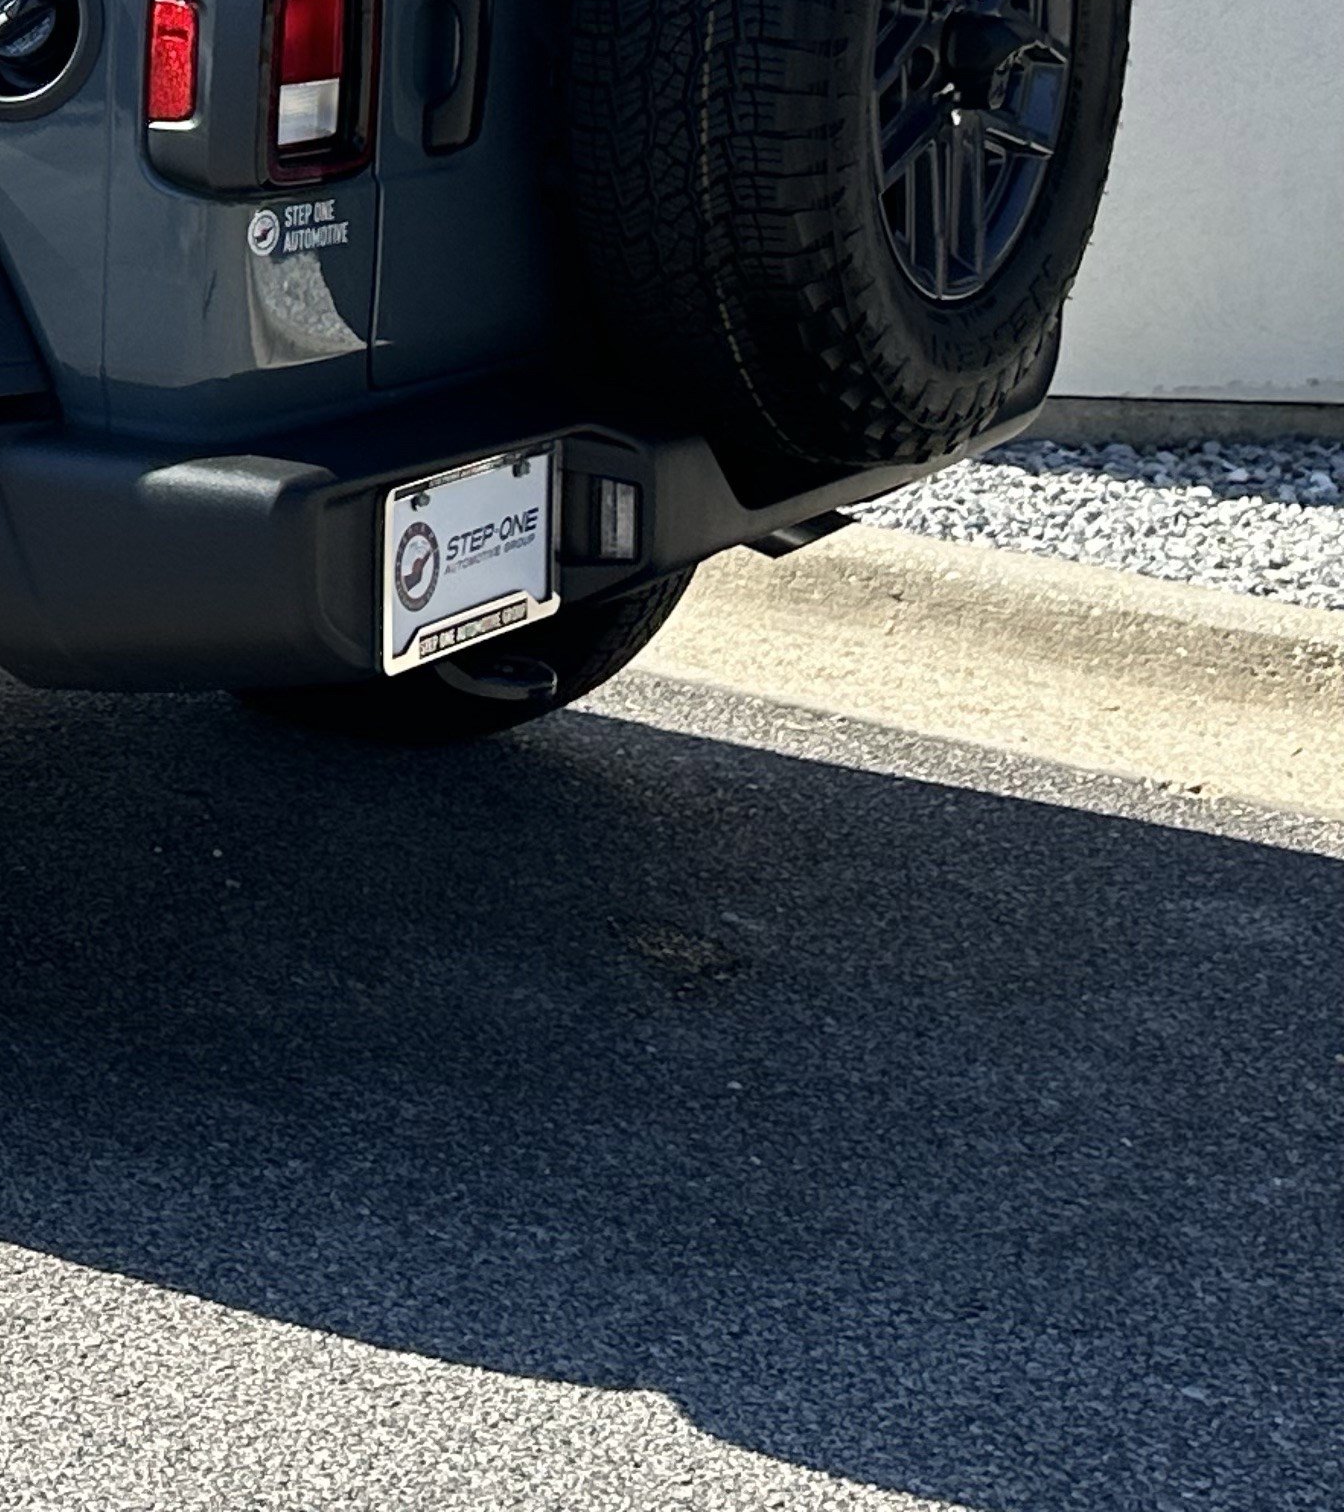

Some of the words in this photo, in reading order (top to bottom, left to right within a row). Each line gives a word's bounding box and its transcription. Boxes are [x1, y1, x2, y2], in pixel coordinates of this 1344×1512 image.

[284, 203, 313, 228] STEP
[313, 199, 336, 223] ONE
[282, 221, 349, 253] AUTOMOTIVE
